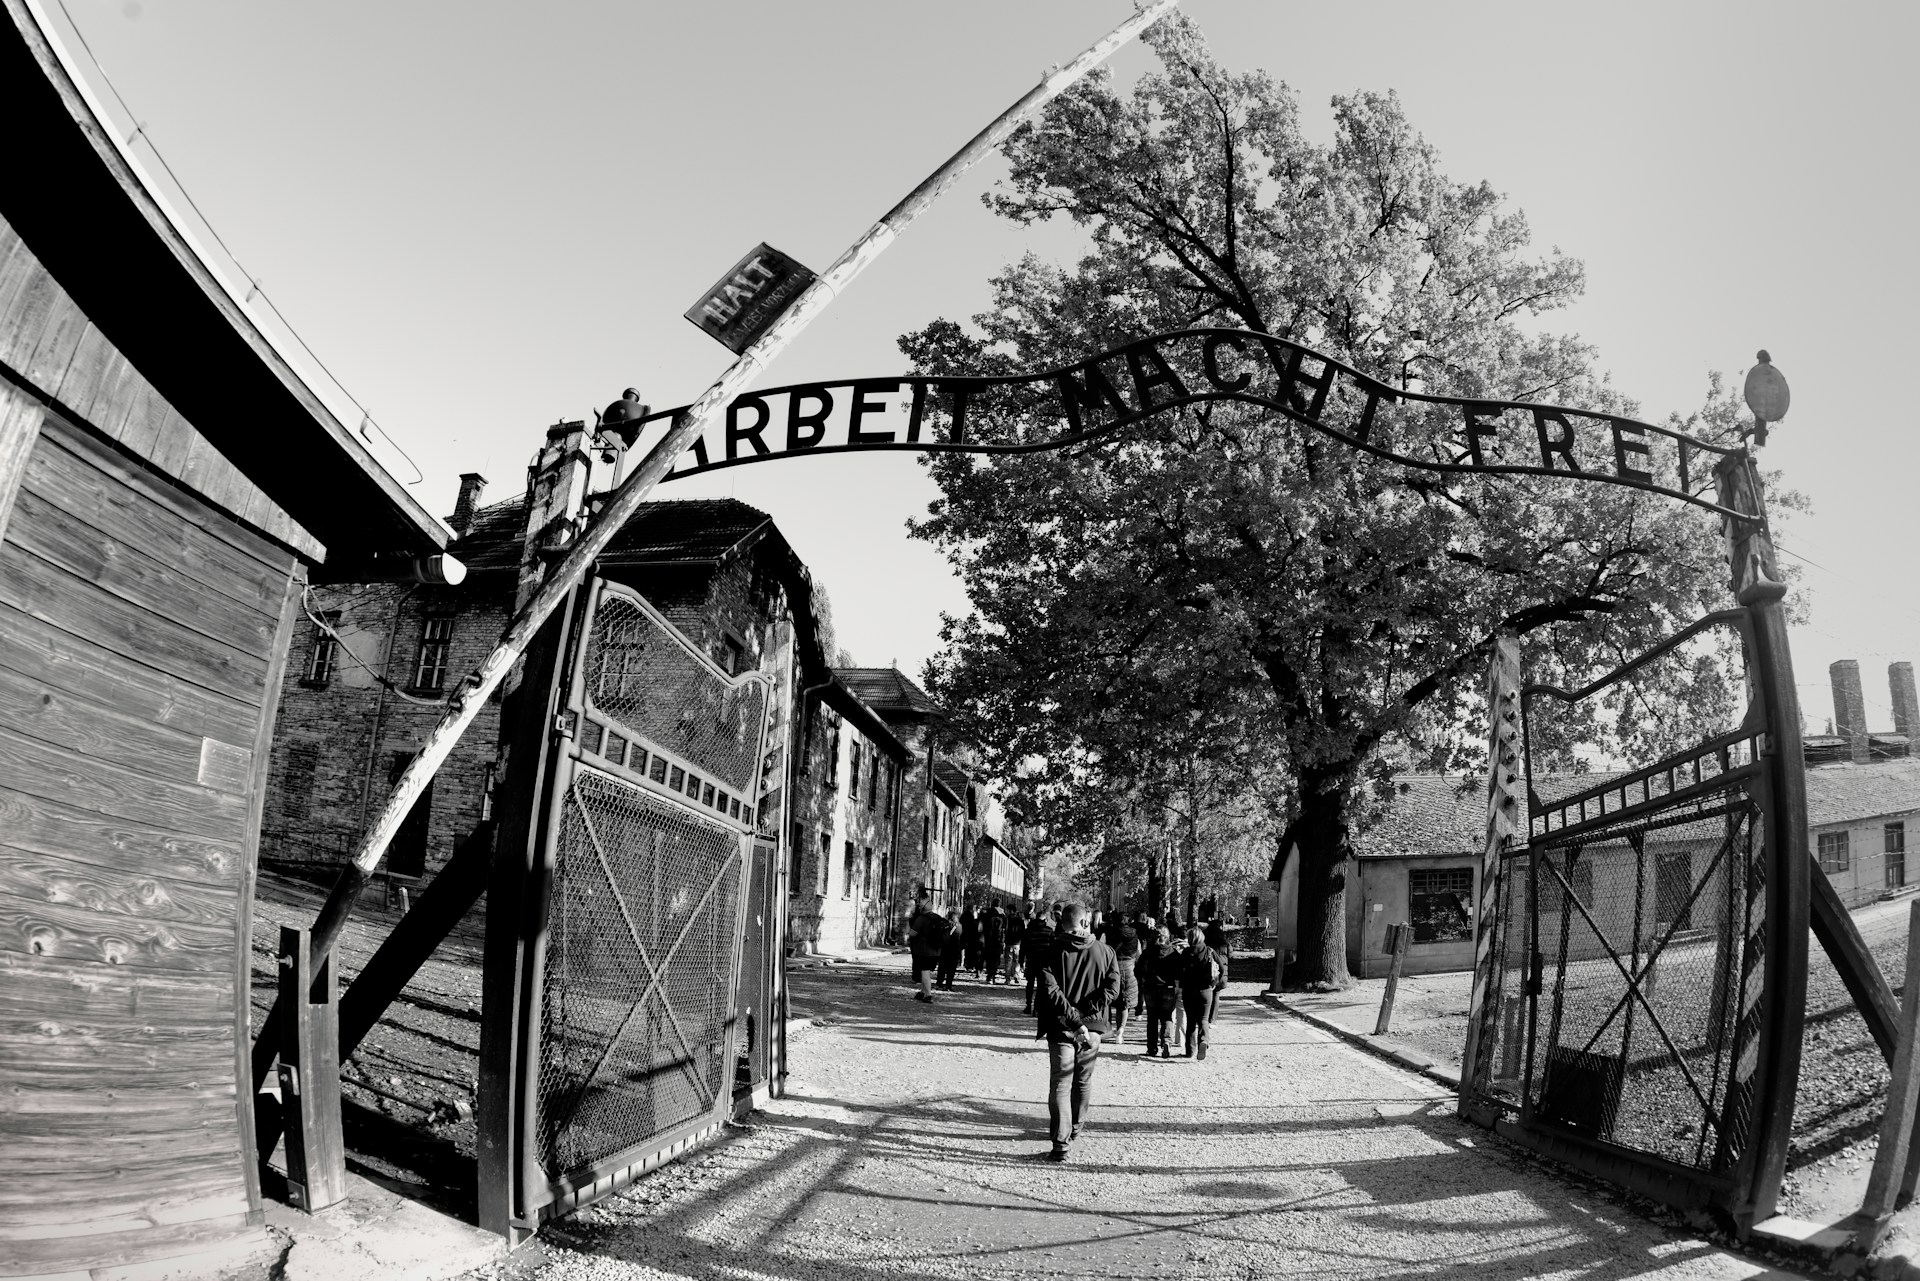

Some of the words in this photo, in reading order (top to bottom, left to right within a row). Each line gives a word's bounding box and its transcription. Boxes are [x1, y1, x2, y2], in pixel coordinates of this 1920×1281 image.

[702, 256, 775, 325] HALT
[660, 378, 987, 474] ARBEIT
[1056, 331, 1398, 441] MACHT
[1462, 402, 1690, 495] FREI
